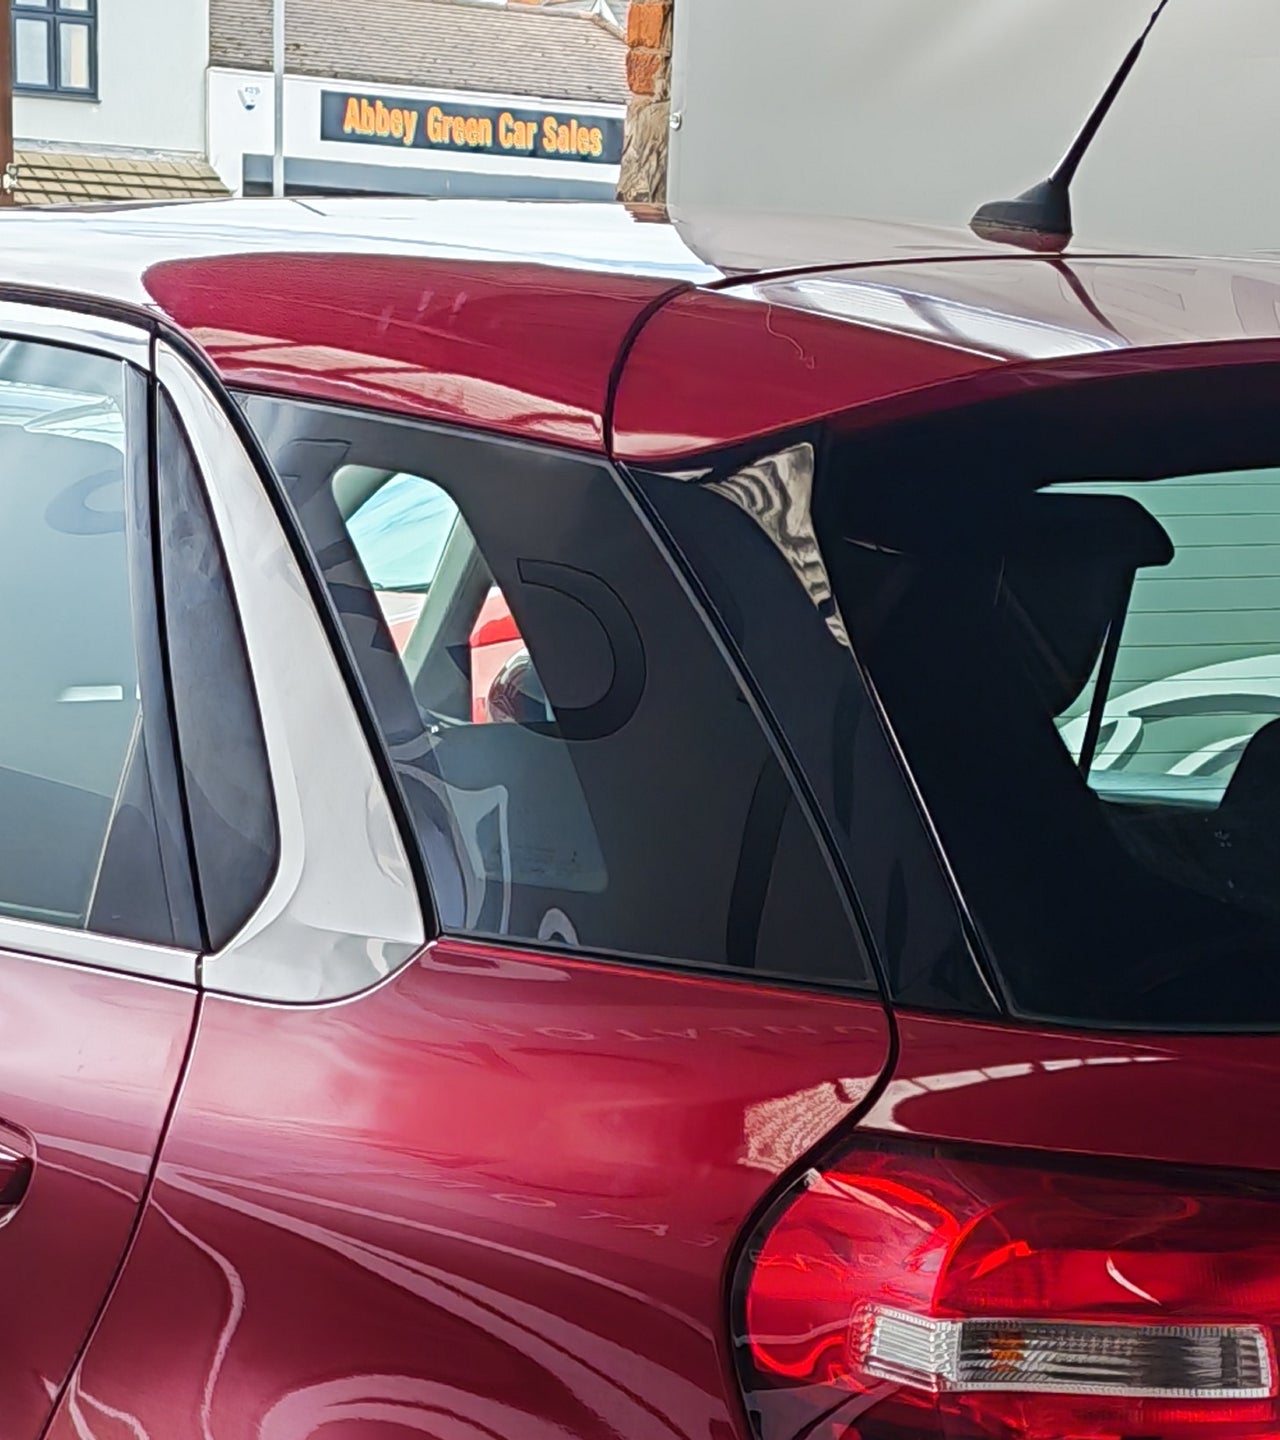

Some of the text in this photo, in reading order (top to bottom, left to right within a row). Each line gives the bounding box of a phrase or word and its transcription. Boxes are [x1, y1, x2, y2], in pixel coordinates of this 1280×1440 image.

[343, 97, 603, 157] Abbey Green Car Sales
